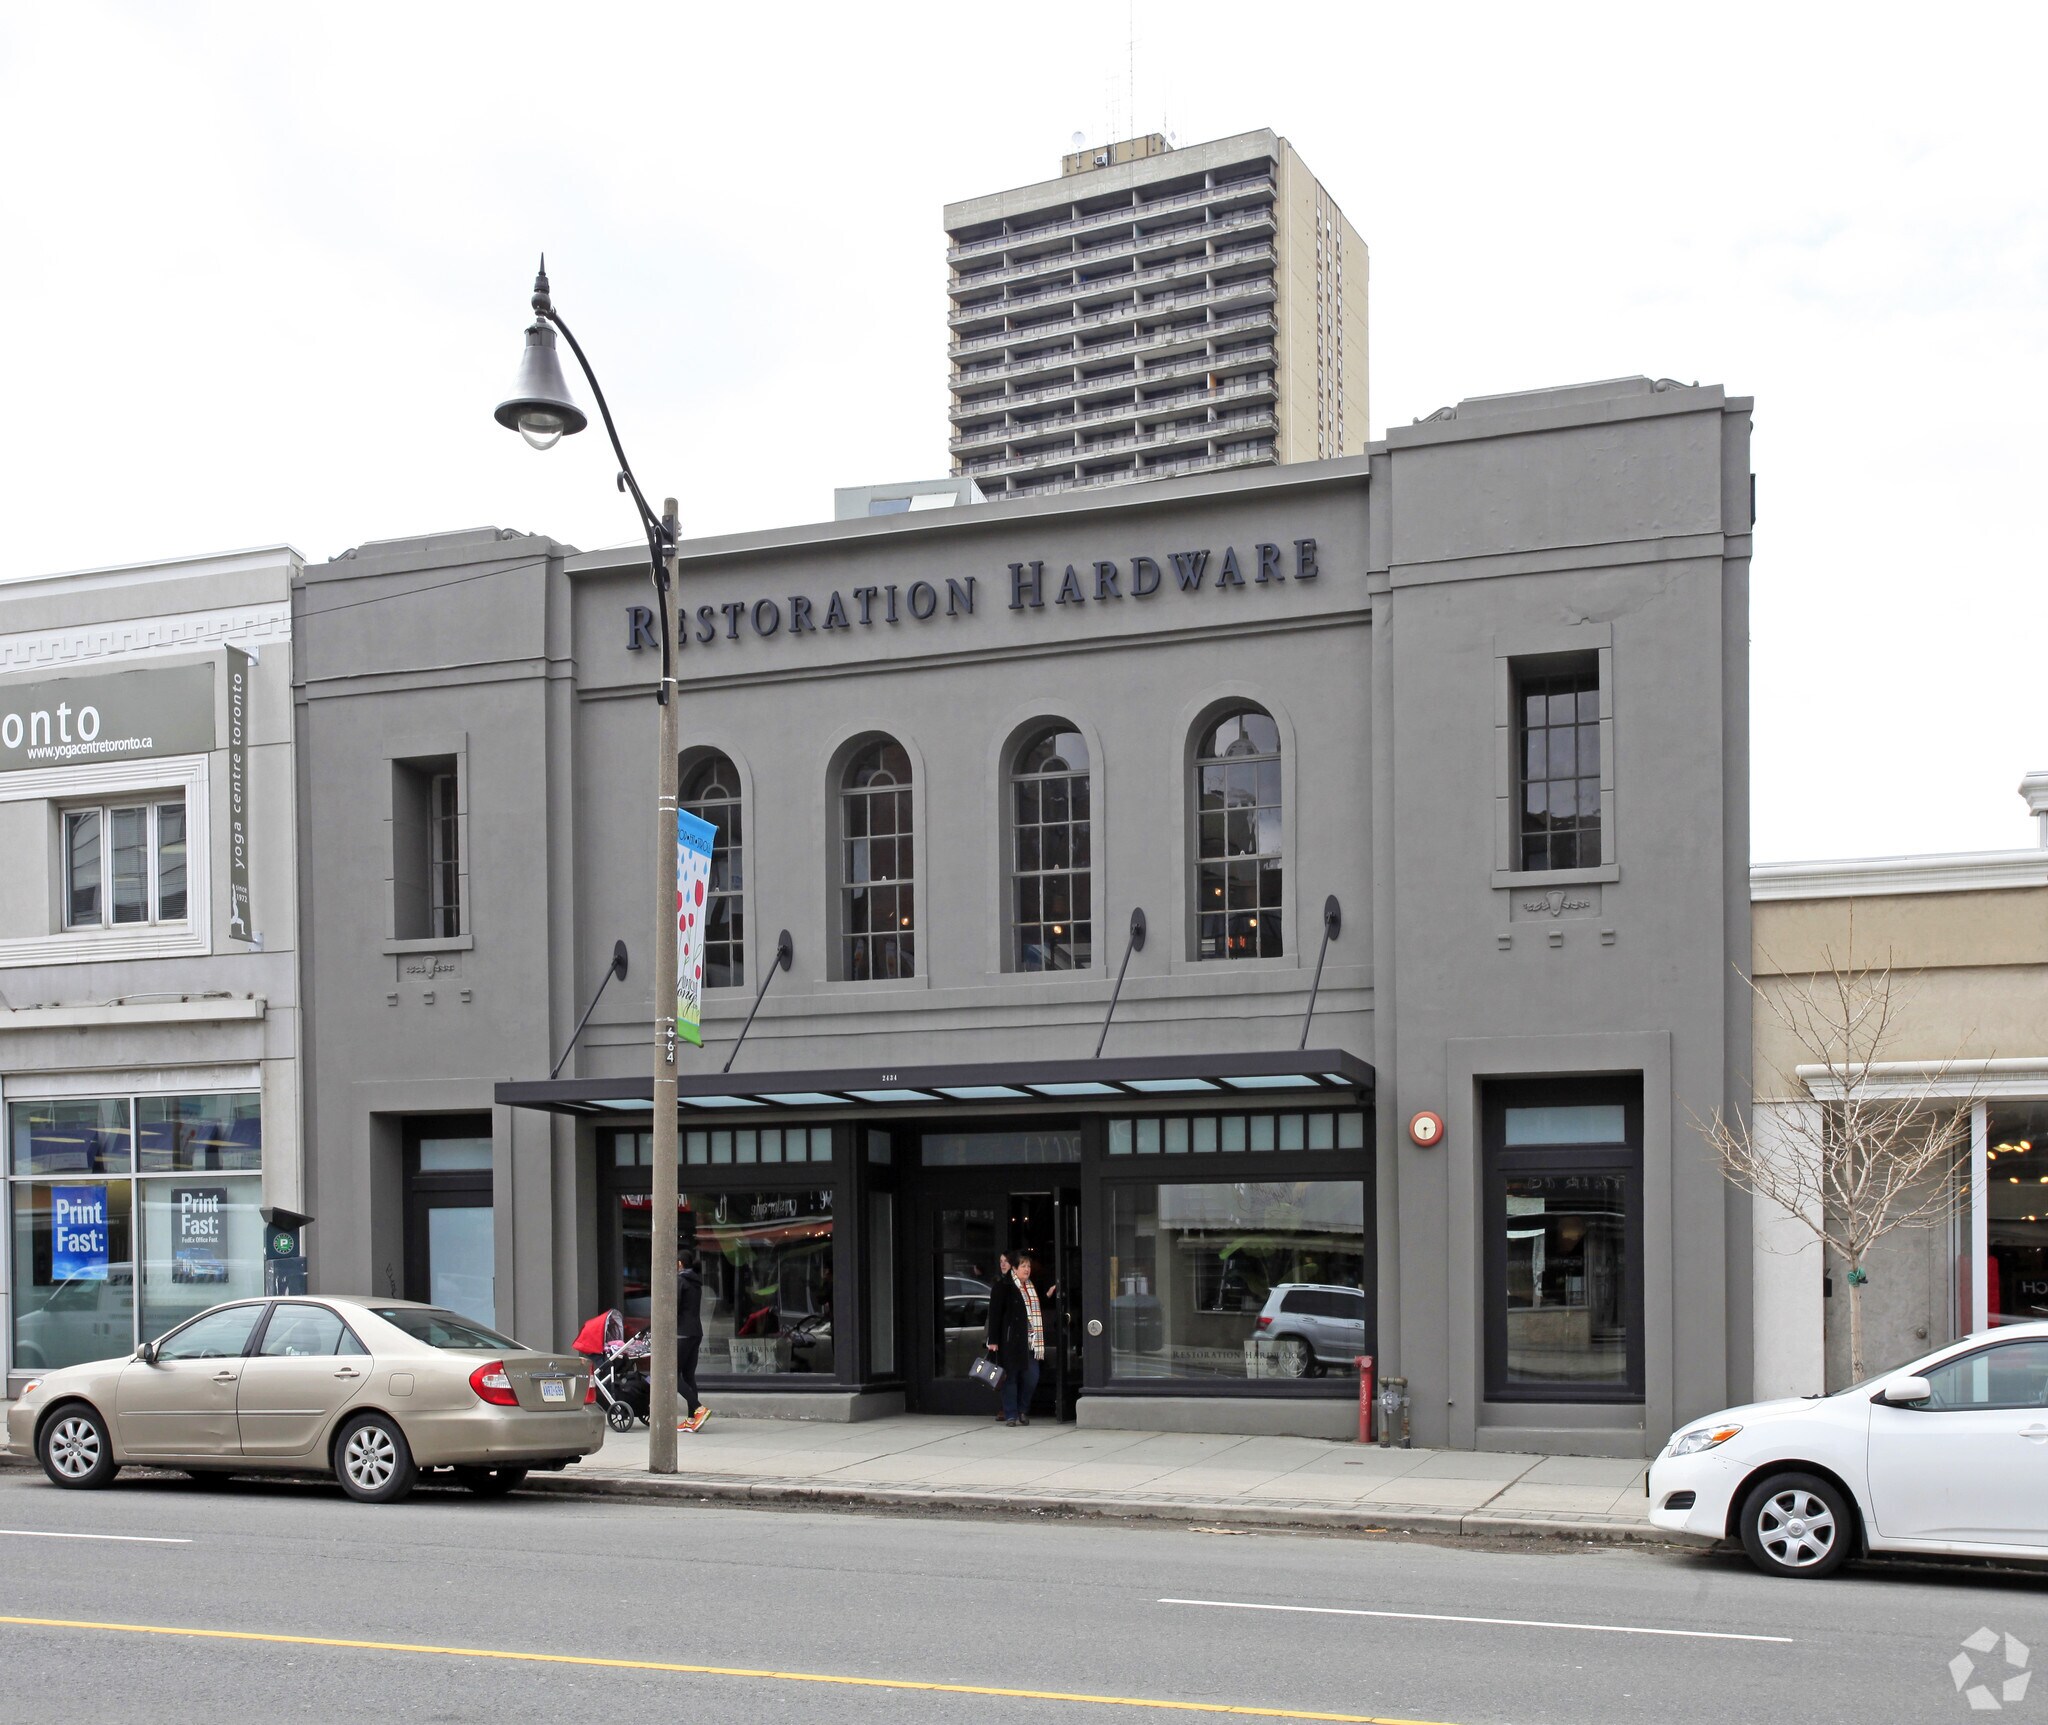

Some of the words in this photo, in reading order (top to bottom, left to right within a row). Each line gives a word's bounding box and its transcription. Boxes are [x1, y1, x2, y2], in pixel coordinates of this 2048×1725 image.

[1007, 538, 1319, 610] HARDWARE
[233, 673, 243, 746] toronto
[1, 701, 101, 749] onto
[27, 736, 153, 760] www.yogacentretoronto.ca
[233, 753, 242, 813] centre
[233, 821, 245, 868] yoga
[56, 1198, 102, 1225] Print
[181, 1192, 219, 1213] Print
[181, 1214, 219, 1235] Fast:
[57, 1226, 104, 1252] Fast:
[1172, 1351, 1240, 1360] RESTORATION
